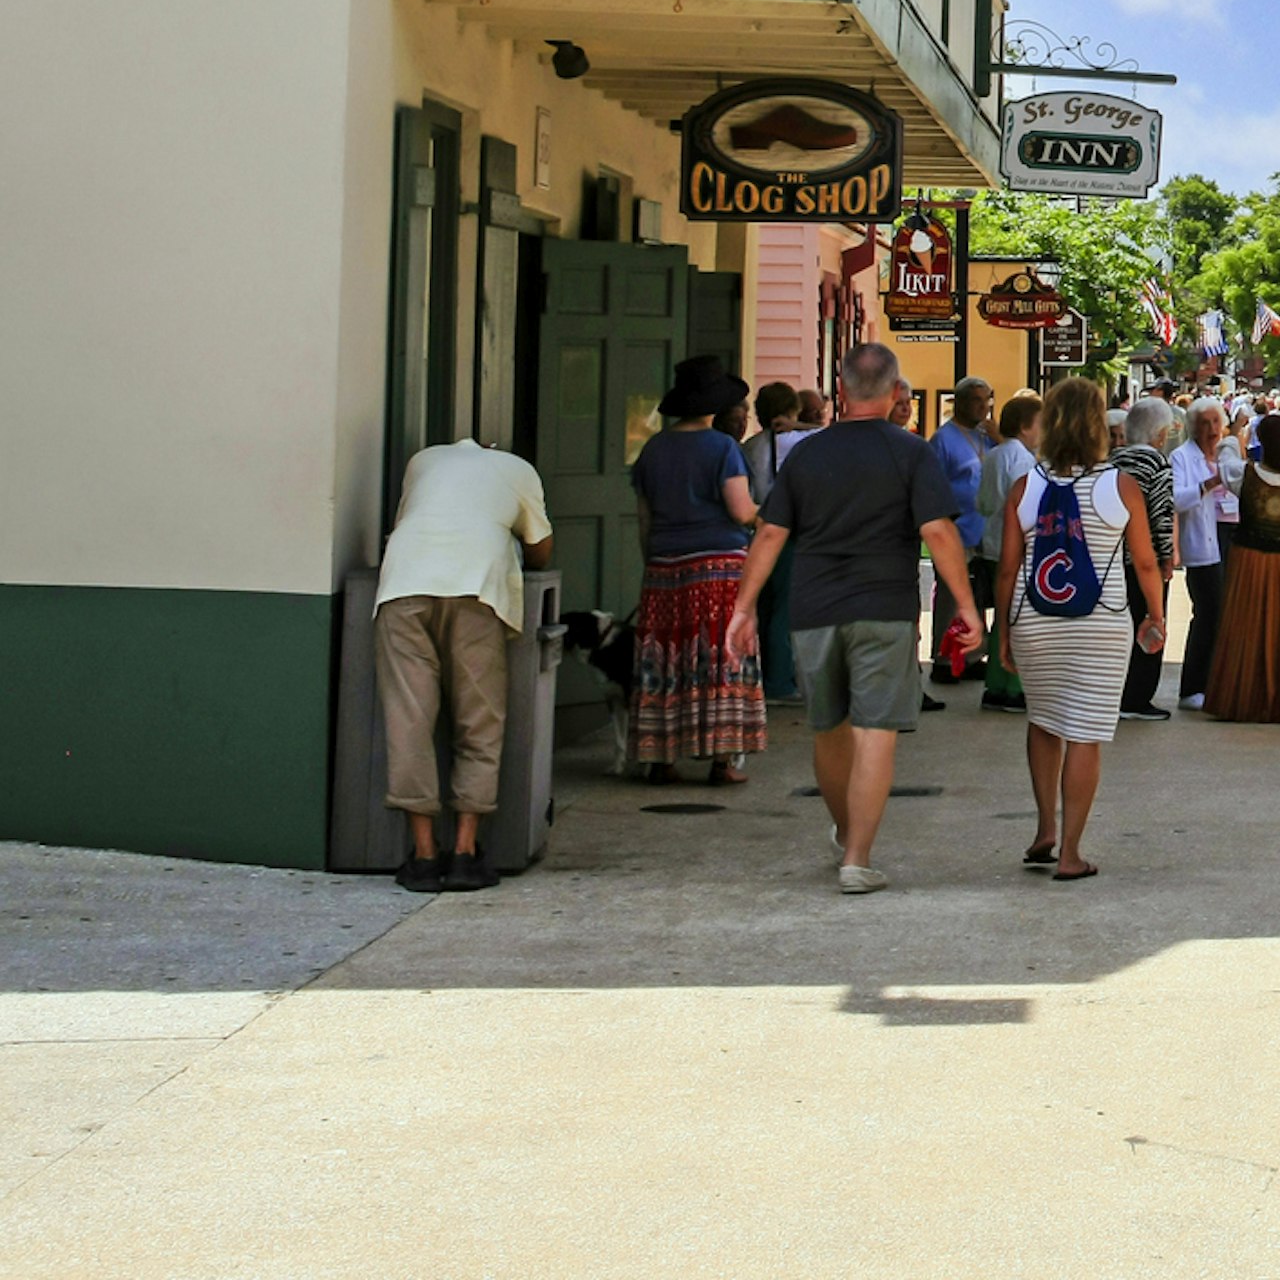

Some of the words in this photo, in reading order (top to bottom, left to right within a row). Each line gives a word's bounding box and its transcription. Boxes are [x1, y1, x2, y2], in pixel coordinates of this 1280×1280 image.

[1023, 101, 1054, 124] St.
[1064, 97, 1143, 129] George
[1038, 139, 1121, 166] INN
[691, 161, 784, 213] CLOG
[796, 163, 890, 215] SHOP
[776, 172, 808, 184] THE
[897, 262, 946, 297] LIKIT
[1035, 300, 1060, 314] GIFTS
[1035, 548, 1077, 604] C
